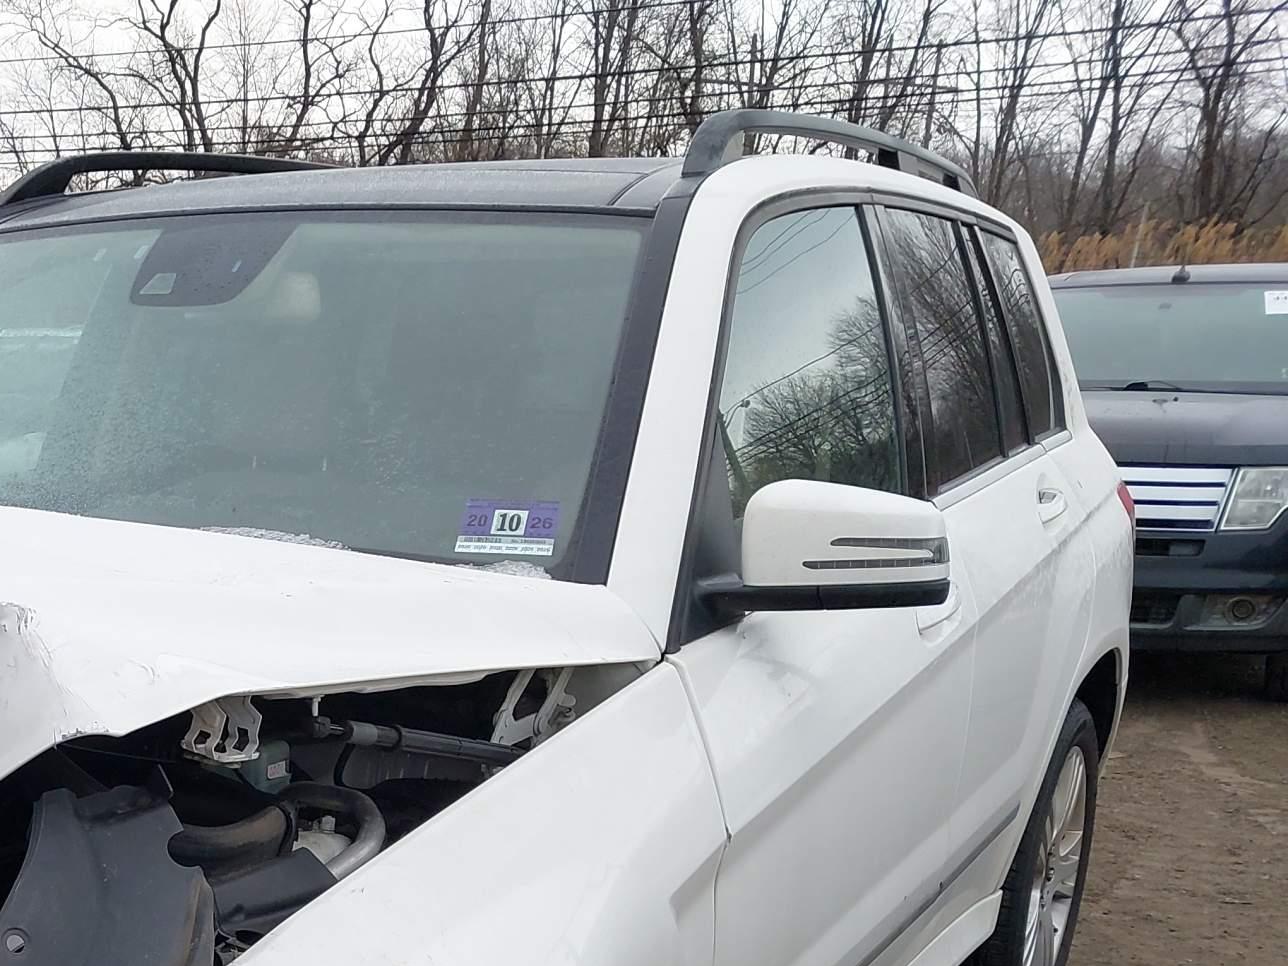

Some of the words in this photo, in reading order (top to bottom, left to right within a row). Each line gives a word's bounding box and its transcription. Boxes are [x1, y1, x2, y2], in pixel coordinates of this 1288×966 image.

[467, 514, 488, 527] 20
[496, 513, 522, 532] 10
[529, 517, 553, 529] 26
